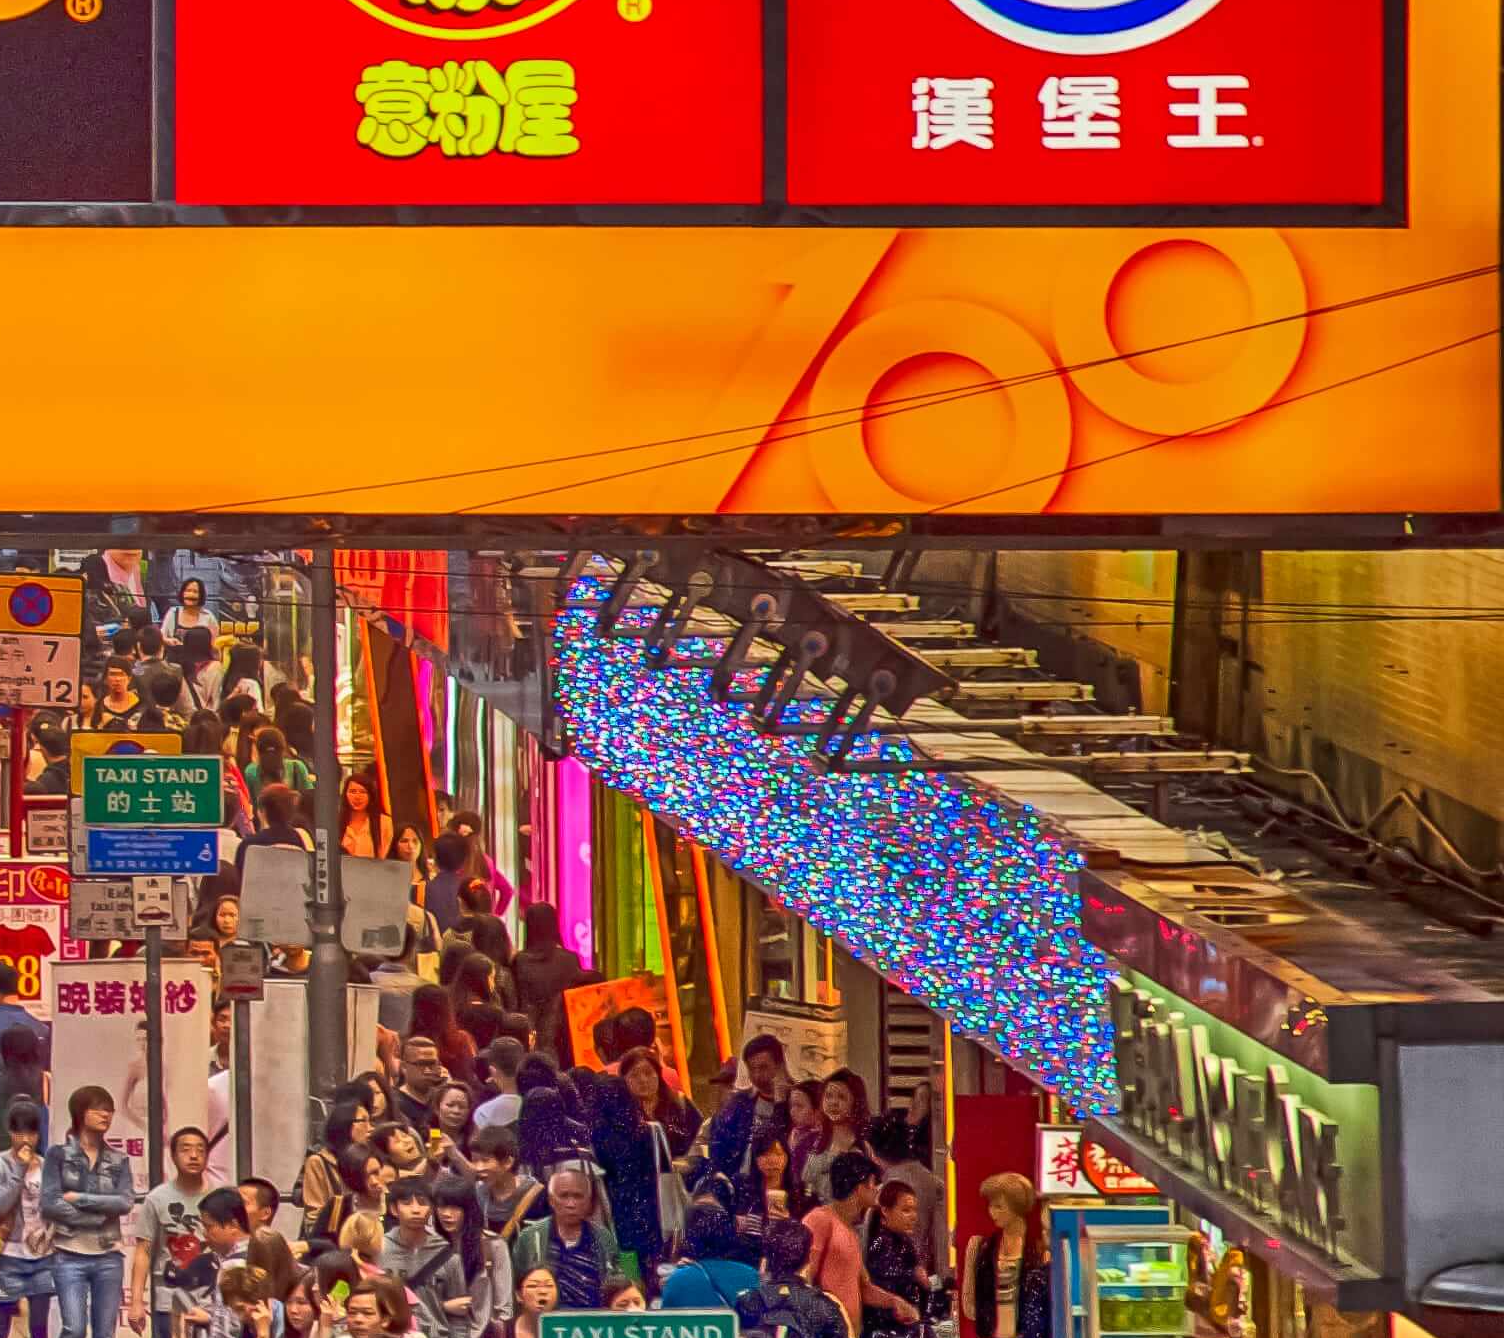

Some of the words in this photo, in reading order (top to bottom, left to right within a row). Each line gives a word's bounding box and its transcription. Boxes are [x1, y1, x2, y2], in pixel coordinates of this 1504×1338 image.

[354, 59, 580, 159] 意粉屋
[910, 73, 1250, 150] 漢堡王
[43, 640, 60, 662] 7
[43, 681, 72, 703] 12
[95, 768, 137, 784] TAXI
[143, 767, 209, 784] STAND
[107, 790, 196, 814] 的士站
